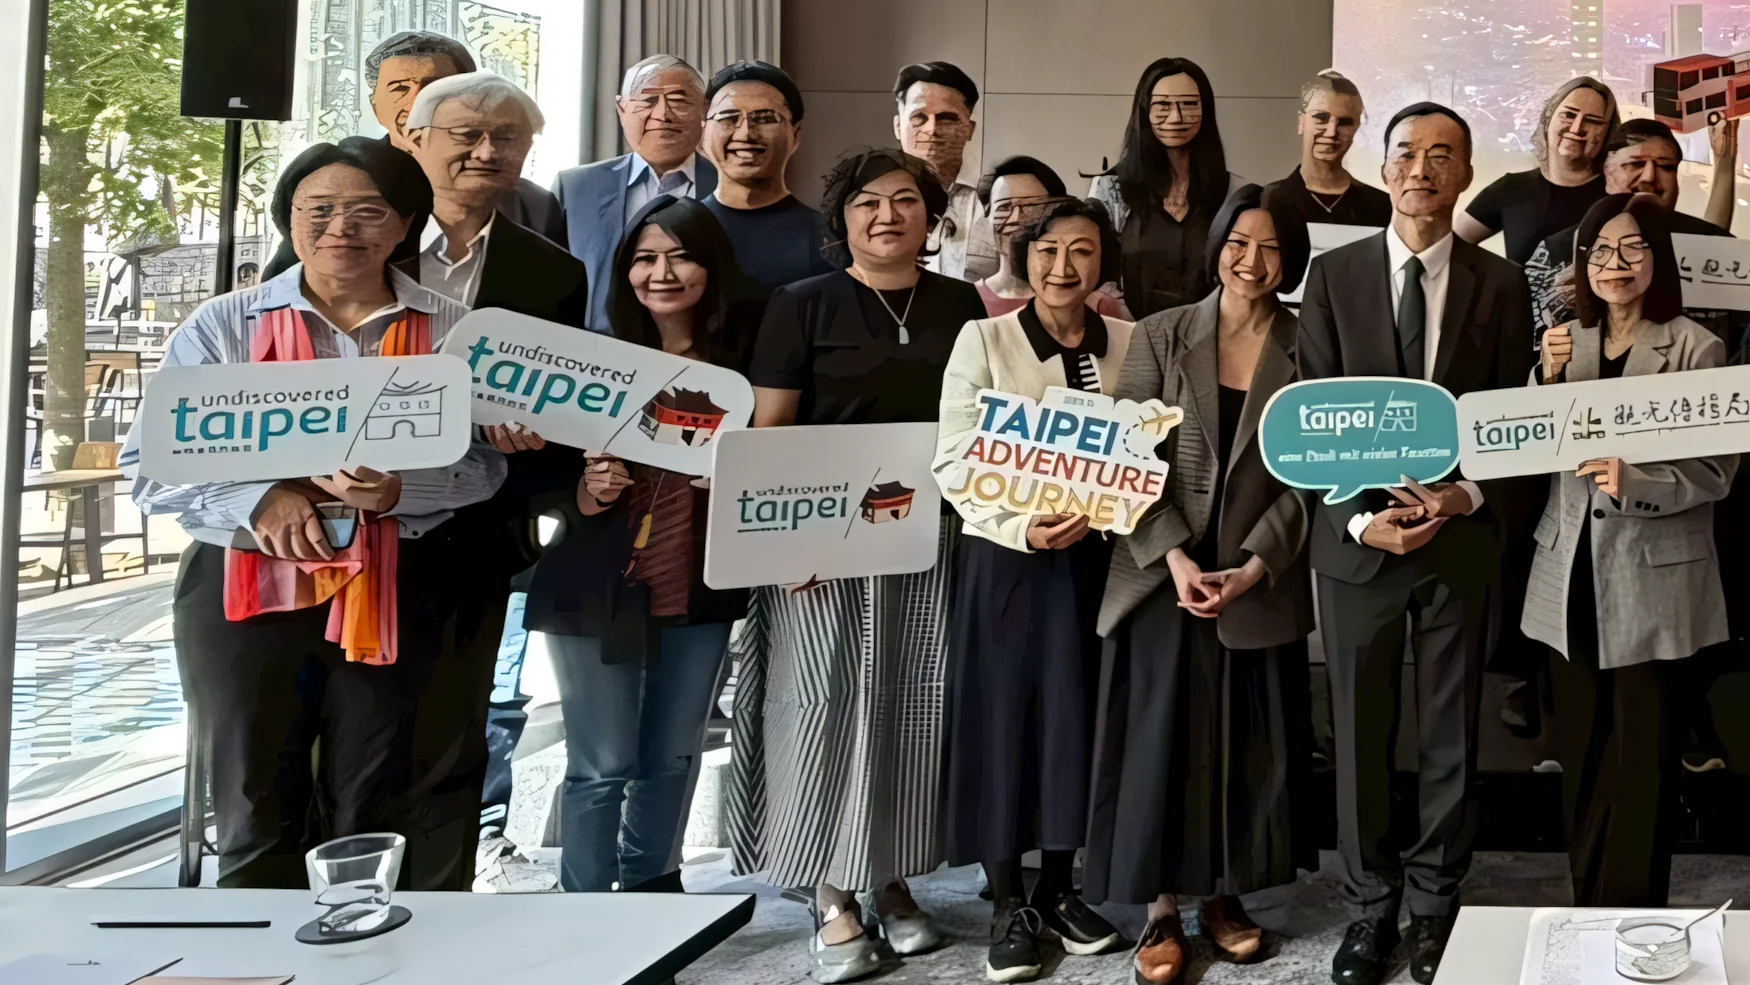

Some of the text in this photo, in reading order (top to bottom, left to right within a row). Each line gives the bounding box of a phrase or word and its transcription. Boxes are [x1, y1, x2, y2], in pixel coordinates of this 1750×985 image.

[468, 336, 628, 418] taipei
[498, 341, 638, 385] undiscovered
[201, 384, 350, 407] undiscovered
[170, 397, 348, 452] taipei
[980, 396, 1120, 455] TAIPEI
[1299, 405, 1374, 436] taipei
[1473, 418, 1555, 450] taipei
[962, 436, 1164, 496] ADVENTURE
[737, 490, 848, 530] taipei
[947, 467, 1146, 528] JOURNEY
